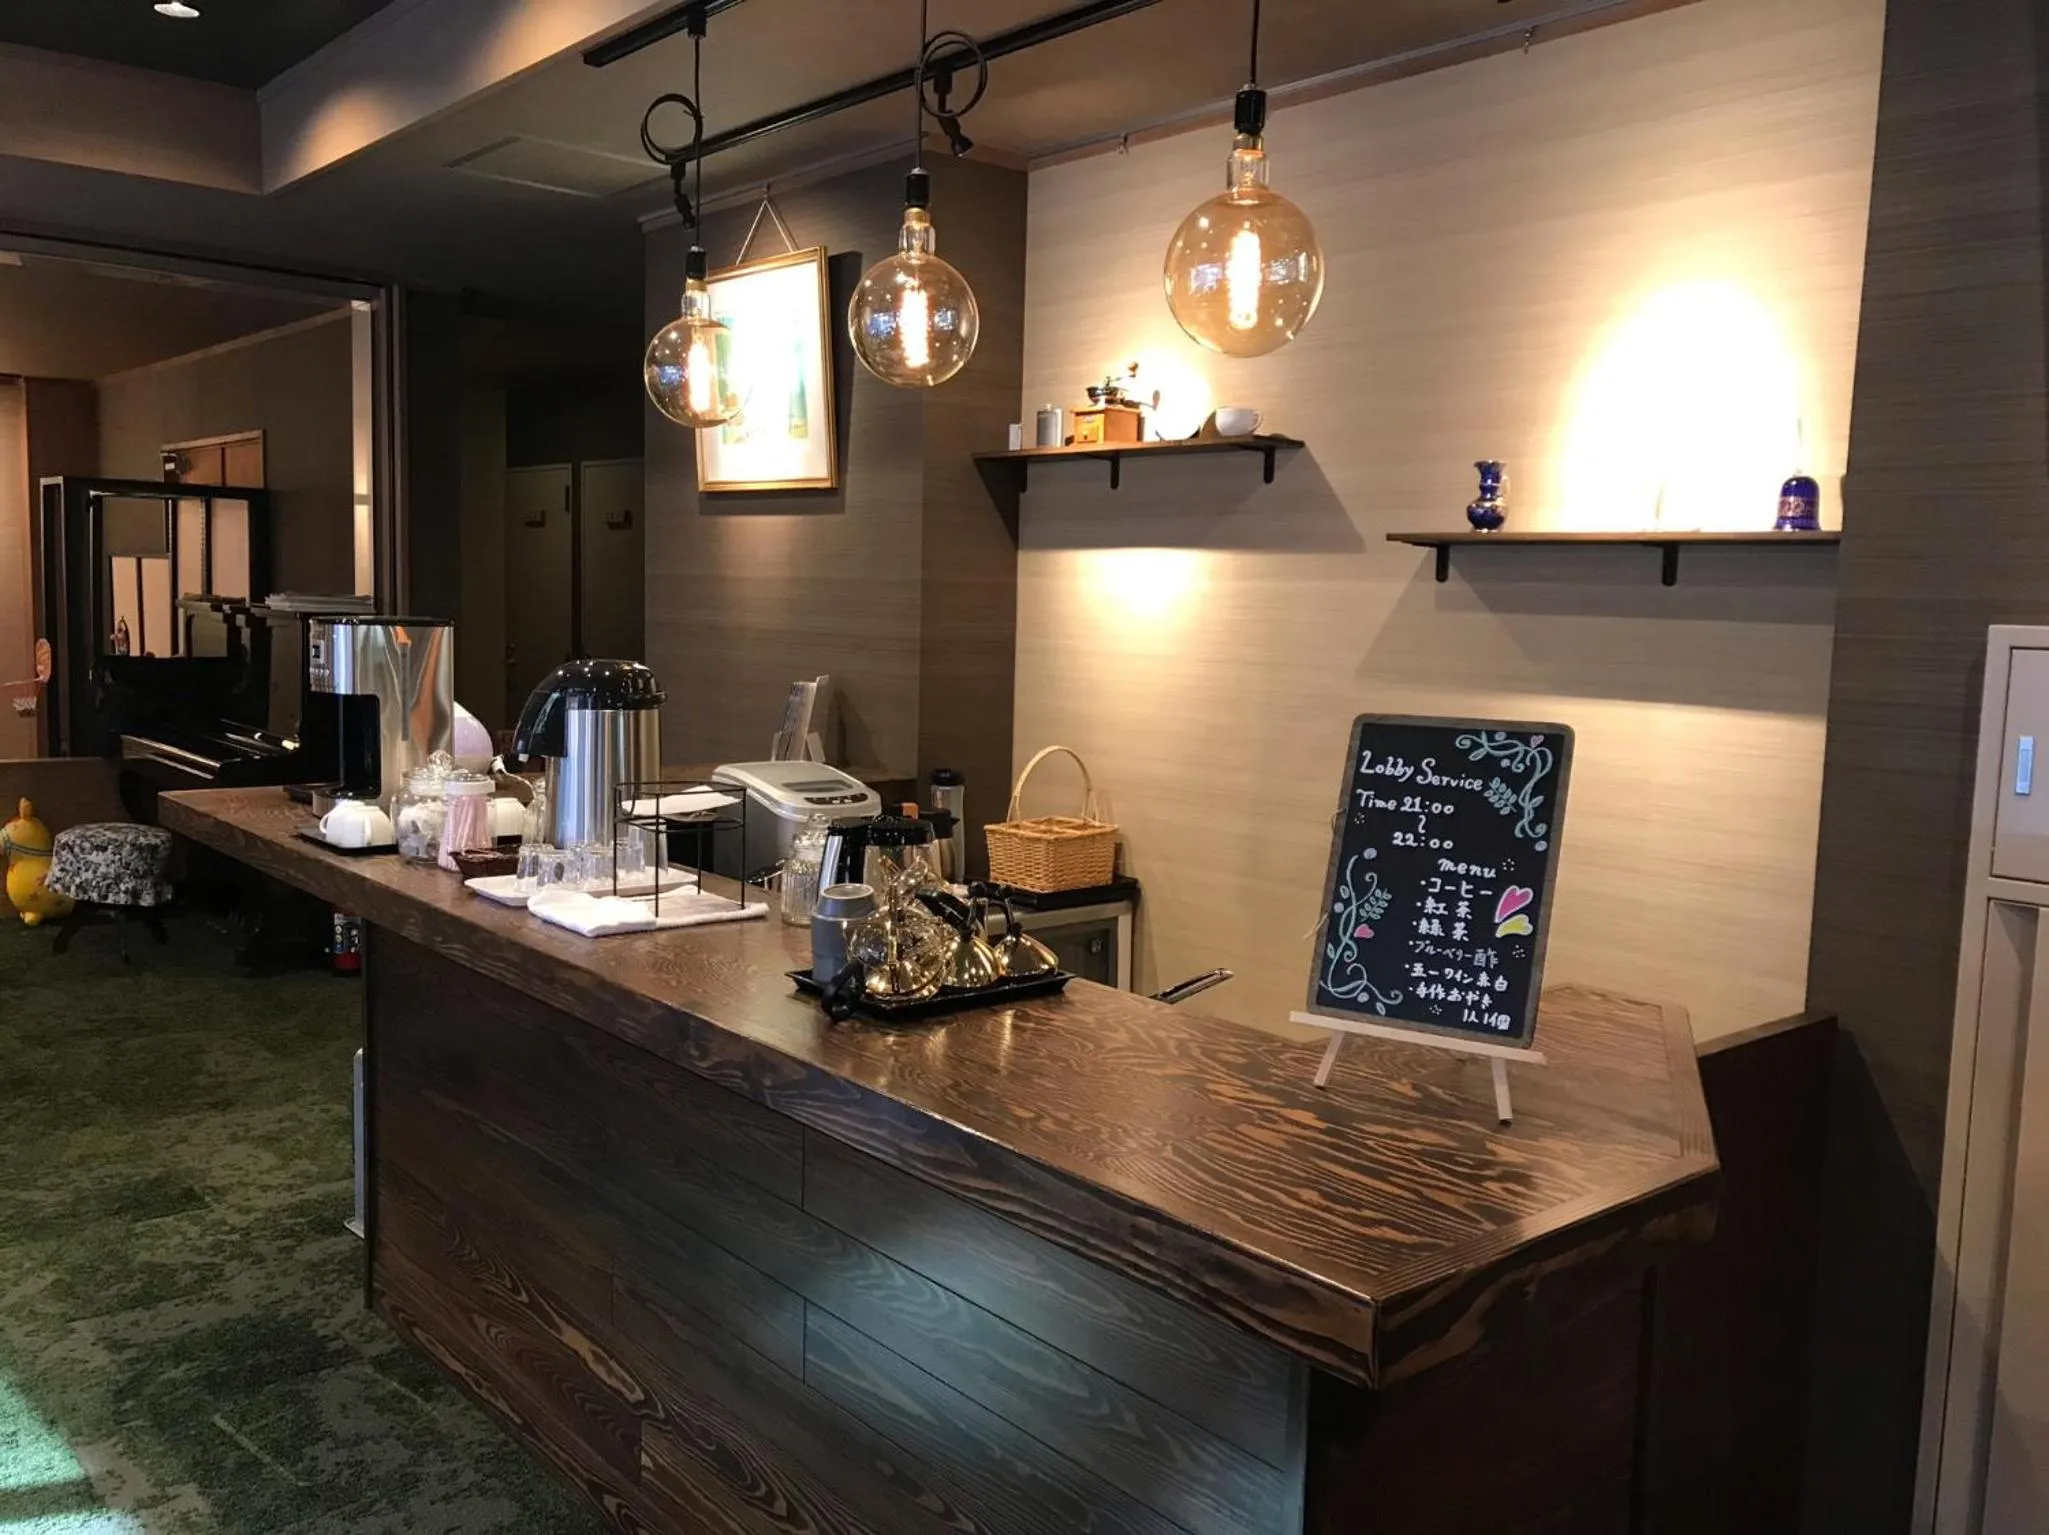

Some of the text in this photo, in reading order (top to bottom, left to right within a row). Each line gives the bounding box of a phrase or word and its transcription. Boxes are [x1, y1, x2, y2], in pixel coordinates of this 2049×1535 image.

[1360, 750, 1484, 791] Lobby Service
[1356, 788, 1455, 815] Time 21:00
[1392, 831, 1454, 850] 22:00
[1437, 857, 1497, 879] menu
